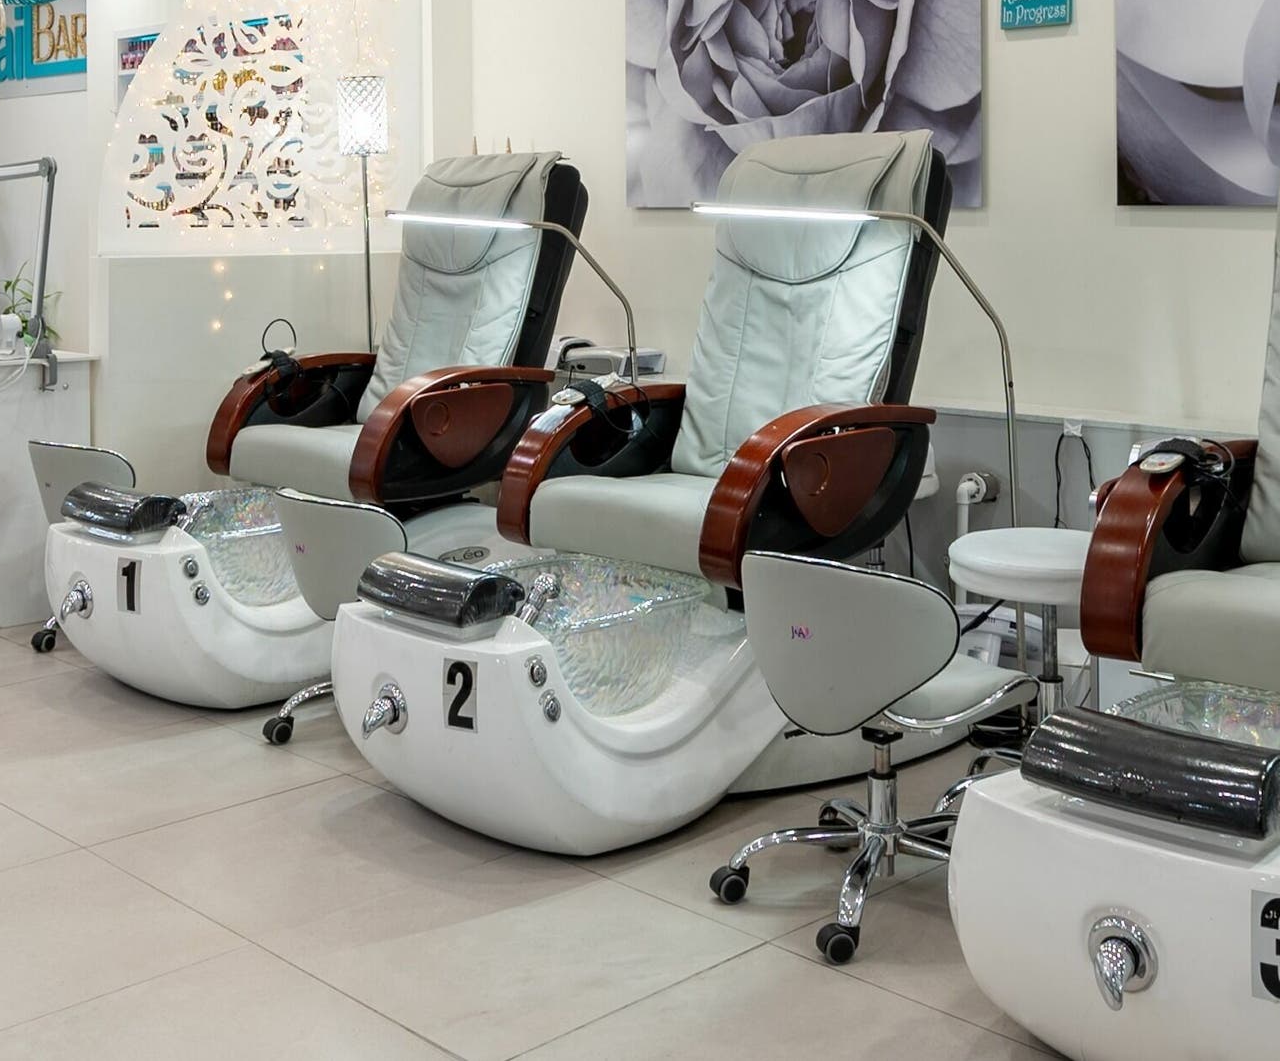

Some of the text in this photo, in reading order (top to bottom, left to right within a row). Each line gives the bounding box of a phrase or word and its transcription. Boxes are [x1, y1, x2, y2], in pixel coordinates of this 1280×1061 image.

[1003, 4, 1066, 25] In Progress
[121, 561, 136, 611] 1
[447, 661, 474, 730] 2
